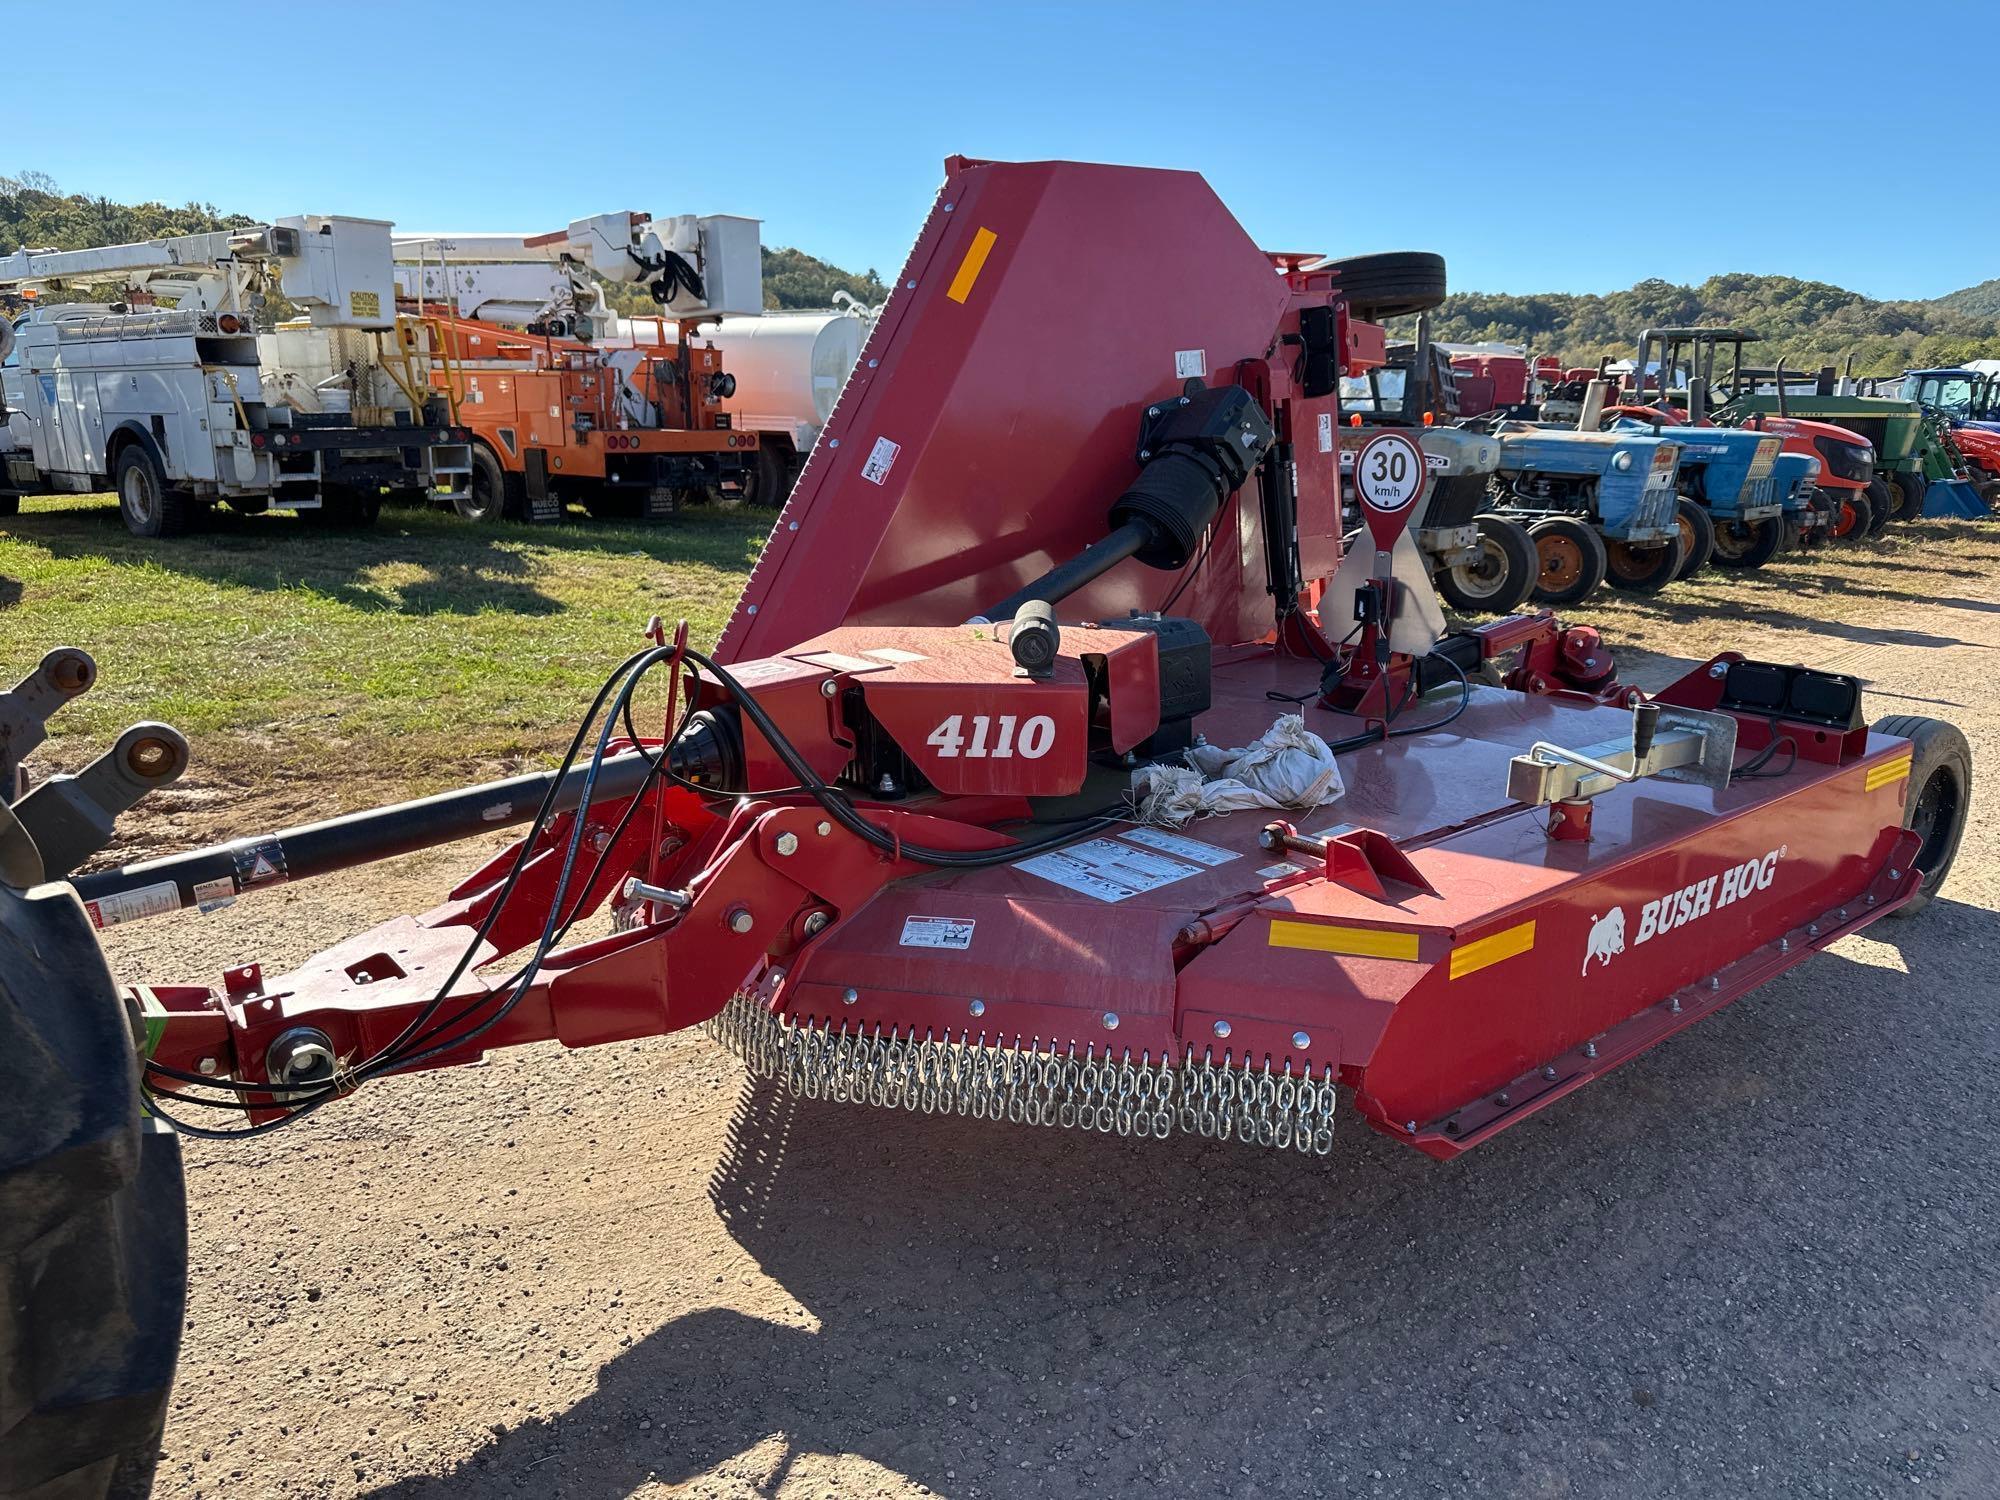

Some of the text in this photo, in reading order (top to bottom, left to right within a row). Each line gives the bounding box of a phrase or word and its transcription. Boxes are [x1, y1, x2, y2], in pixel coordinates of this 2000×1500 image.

[1372, 451, 1407, 483] 30
[1374, 485, 1401, 498] km/h
[926, 714, 1056, 759] 4110
[1634, 874, 1719, 946] BUSH
